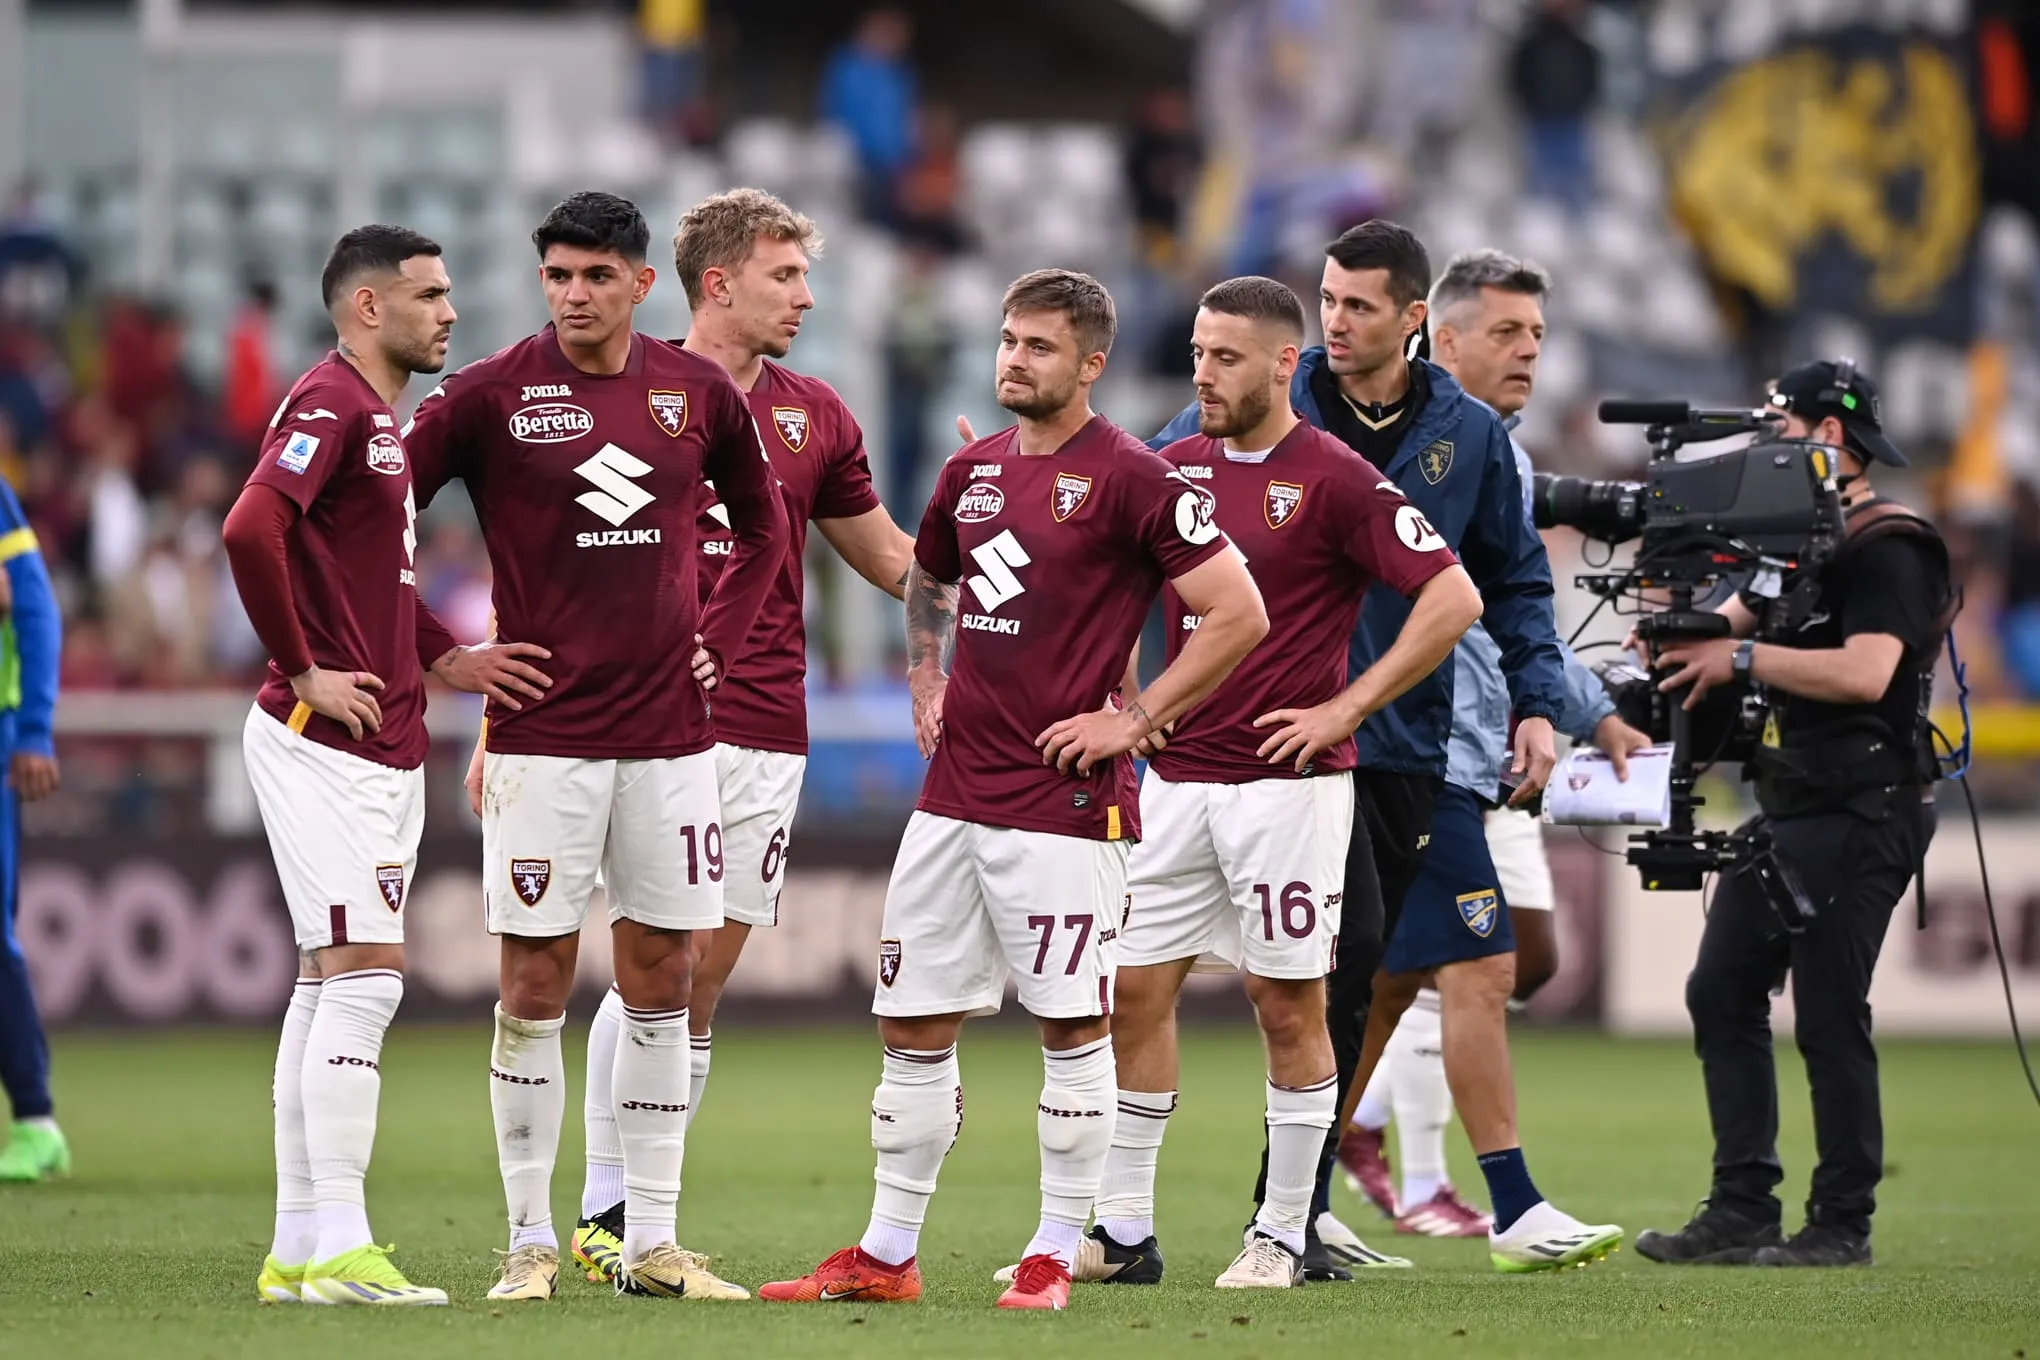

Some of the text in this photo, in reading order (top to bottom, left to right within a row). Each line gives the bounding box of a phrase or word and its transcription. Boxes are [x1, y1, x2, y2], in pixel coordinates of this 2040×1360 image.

[521, 384, 572, 401] Joma
[654, 396, 681, 404] TORINO
[513, 411, 590, 436] Beretta
[778, 412, 803, 421] TORINO
[1060, 479, 1086, 491] TORINO
[1272, 487, 1298, 498] TORINO
[575, 528, 661, 548] SUZUKI
[961, 613, 1021, 635] SUZUKI
[680, 822, 724, 885] 19
[515, 864, 547, 872] TORINO
[535, 874, 547, 882] FC
[1253, 880, 1316, 941] 16
[880, 945, 898, 953] ORINO
[1027, 914, 1094, 976] 77
[622, 1100, 689, 1113] Jom
[1038, 1103, 1104, 1118] oma
